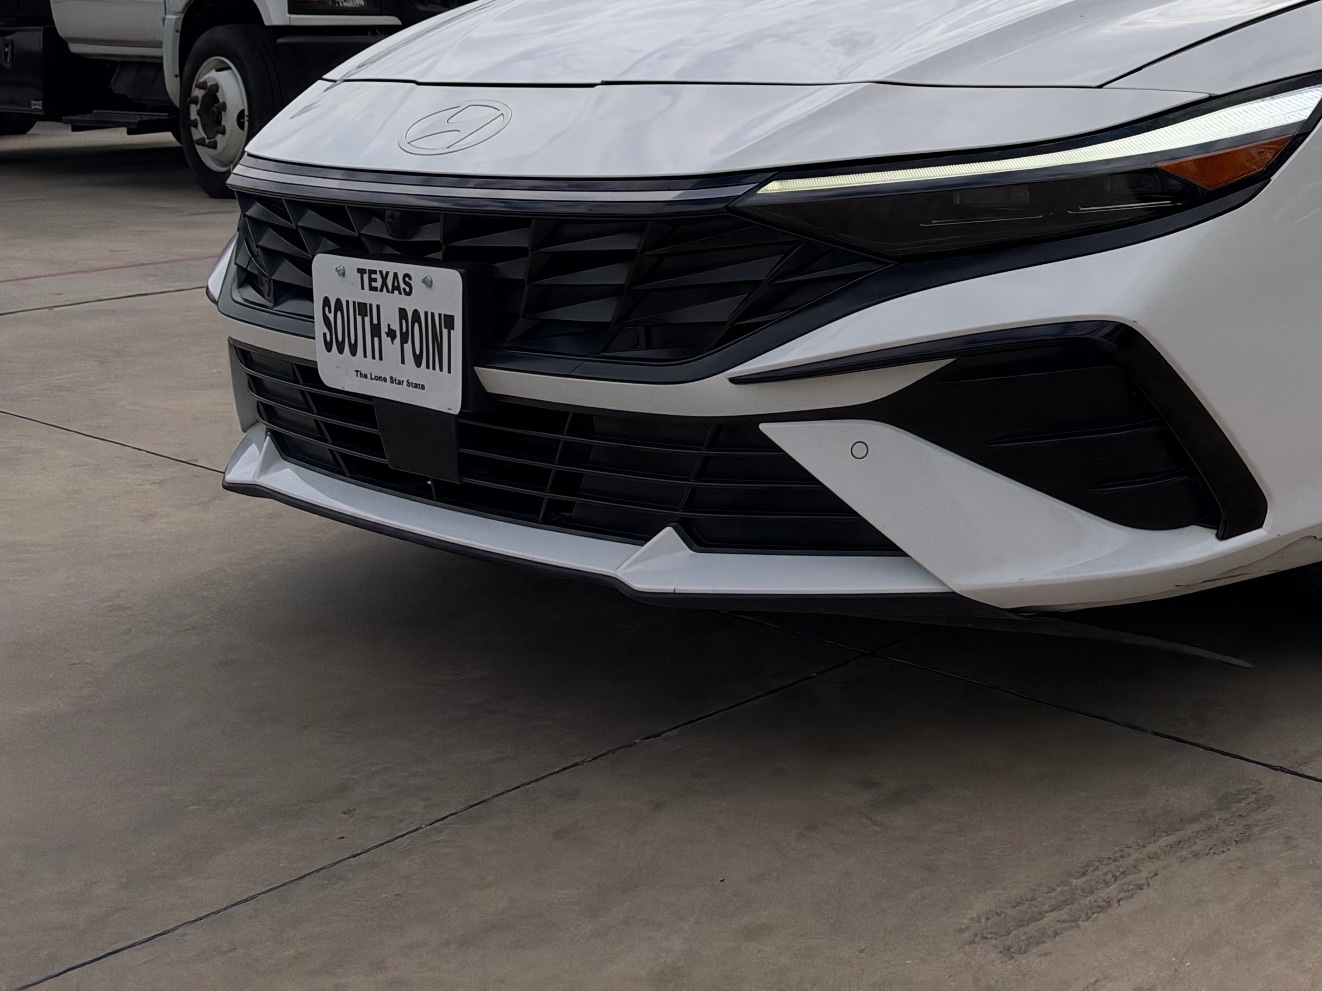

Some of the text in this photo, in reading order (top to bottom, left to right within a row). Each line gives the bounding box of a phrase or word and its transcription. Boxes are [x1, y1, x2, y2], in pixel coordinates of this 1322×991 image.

[356, 267, 413, 297] TEXAS
[322, 295, 455, 374] SOUTH POINT
[354, 369, 425, 390] The Lone Star State
